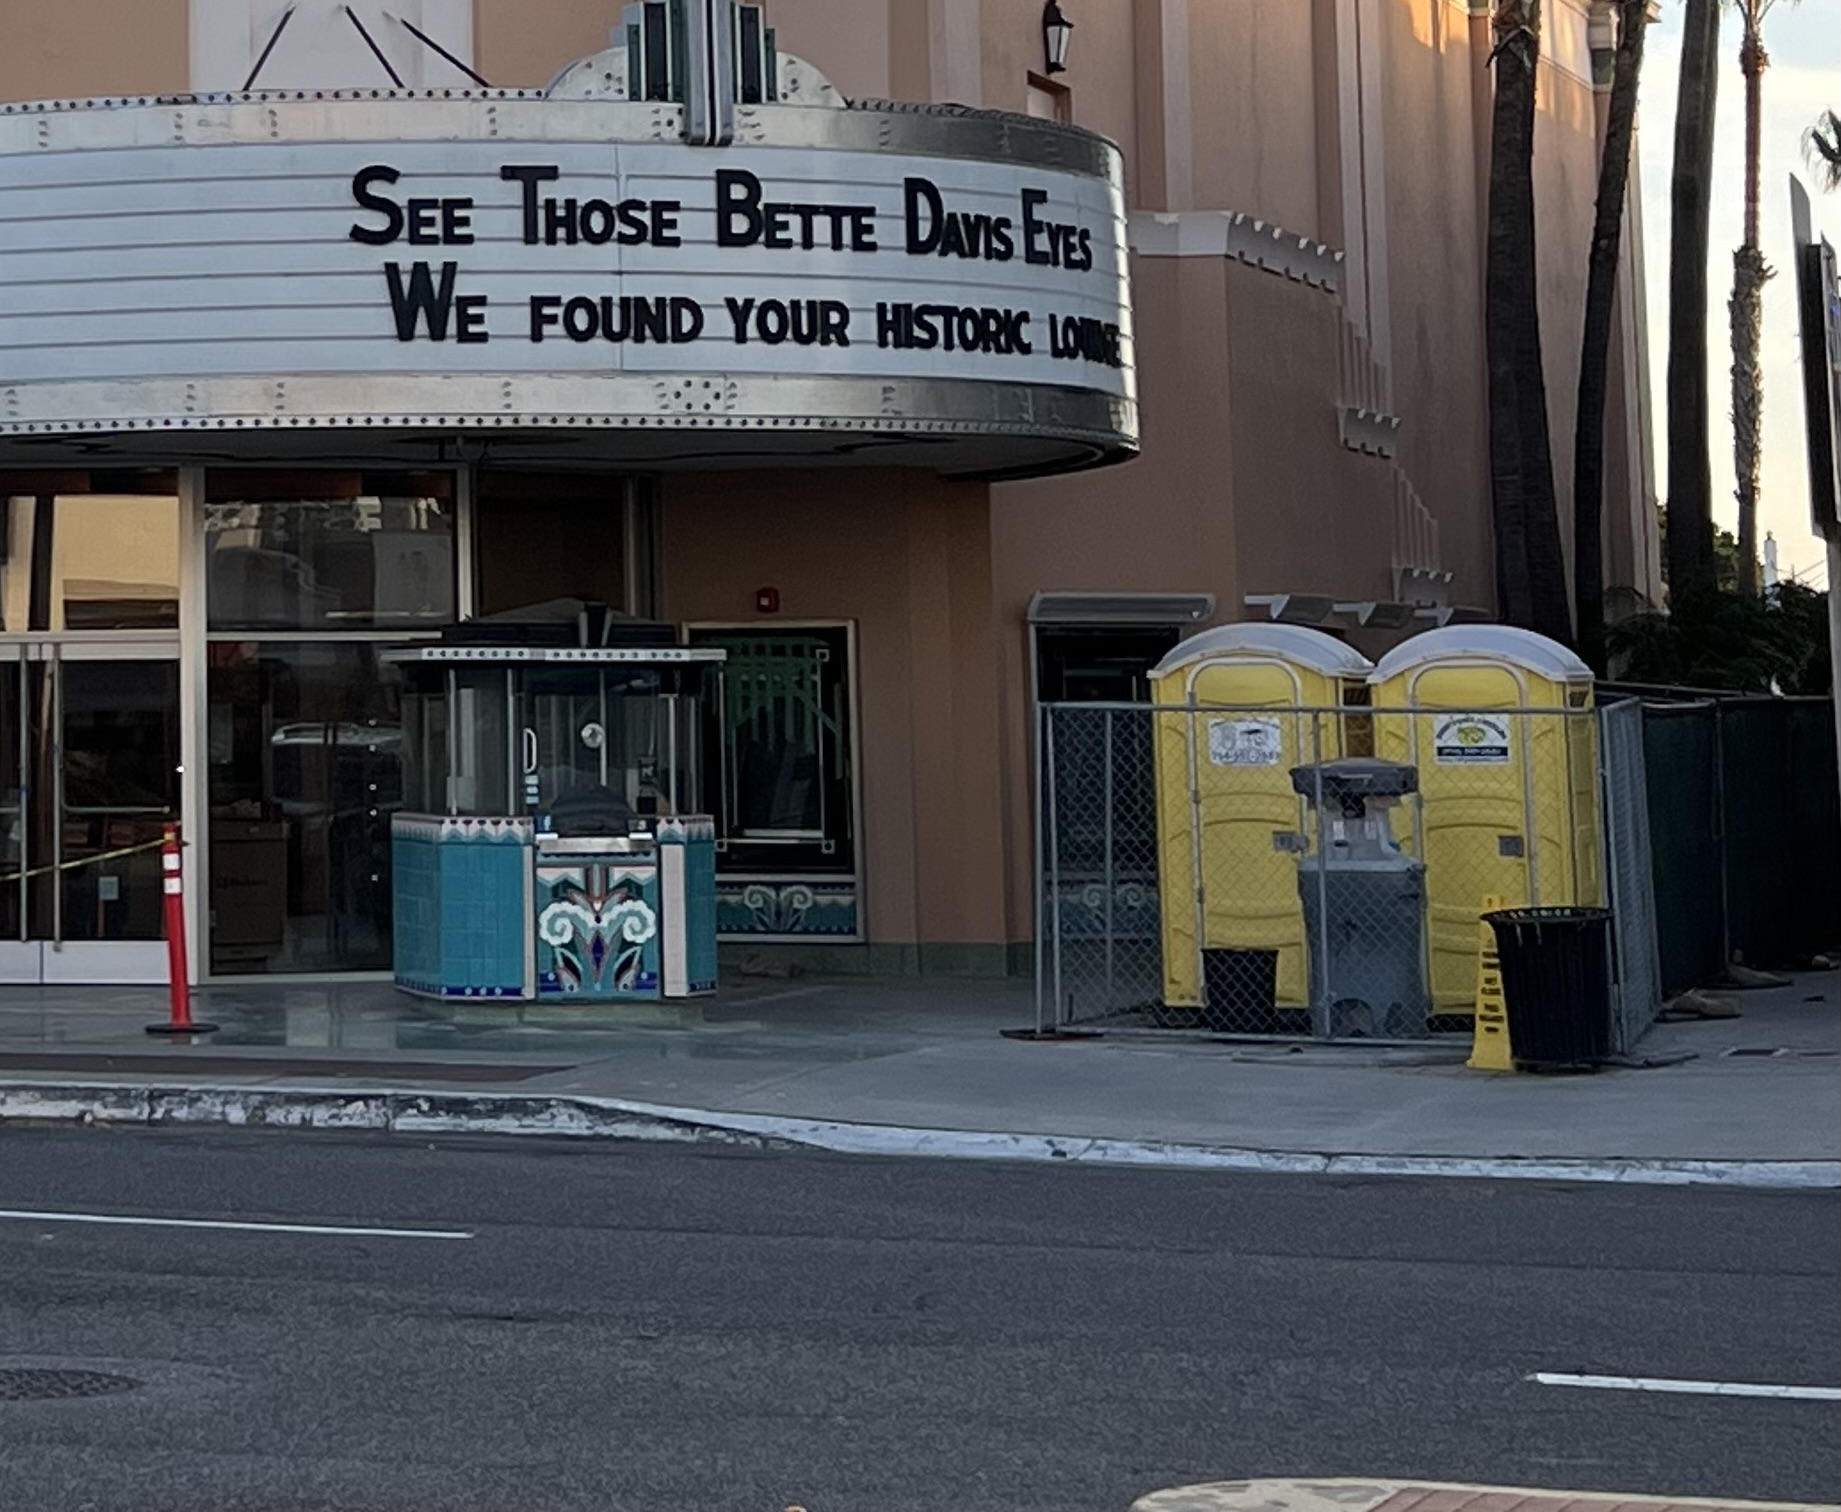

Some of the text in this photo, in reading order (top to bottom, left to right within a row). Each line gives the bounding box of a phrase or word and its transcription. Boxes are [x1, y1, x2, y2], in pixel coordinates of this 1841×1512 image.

[529, 295, 704, 344] FOUND
[724, 297, 851, 347] YOUR
[876, 301, 1033, 356] HISTORIC
